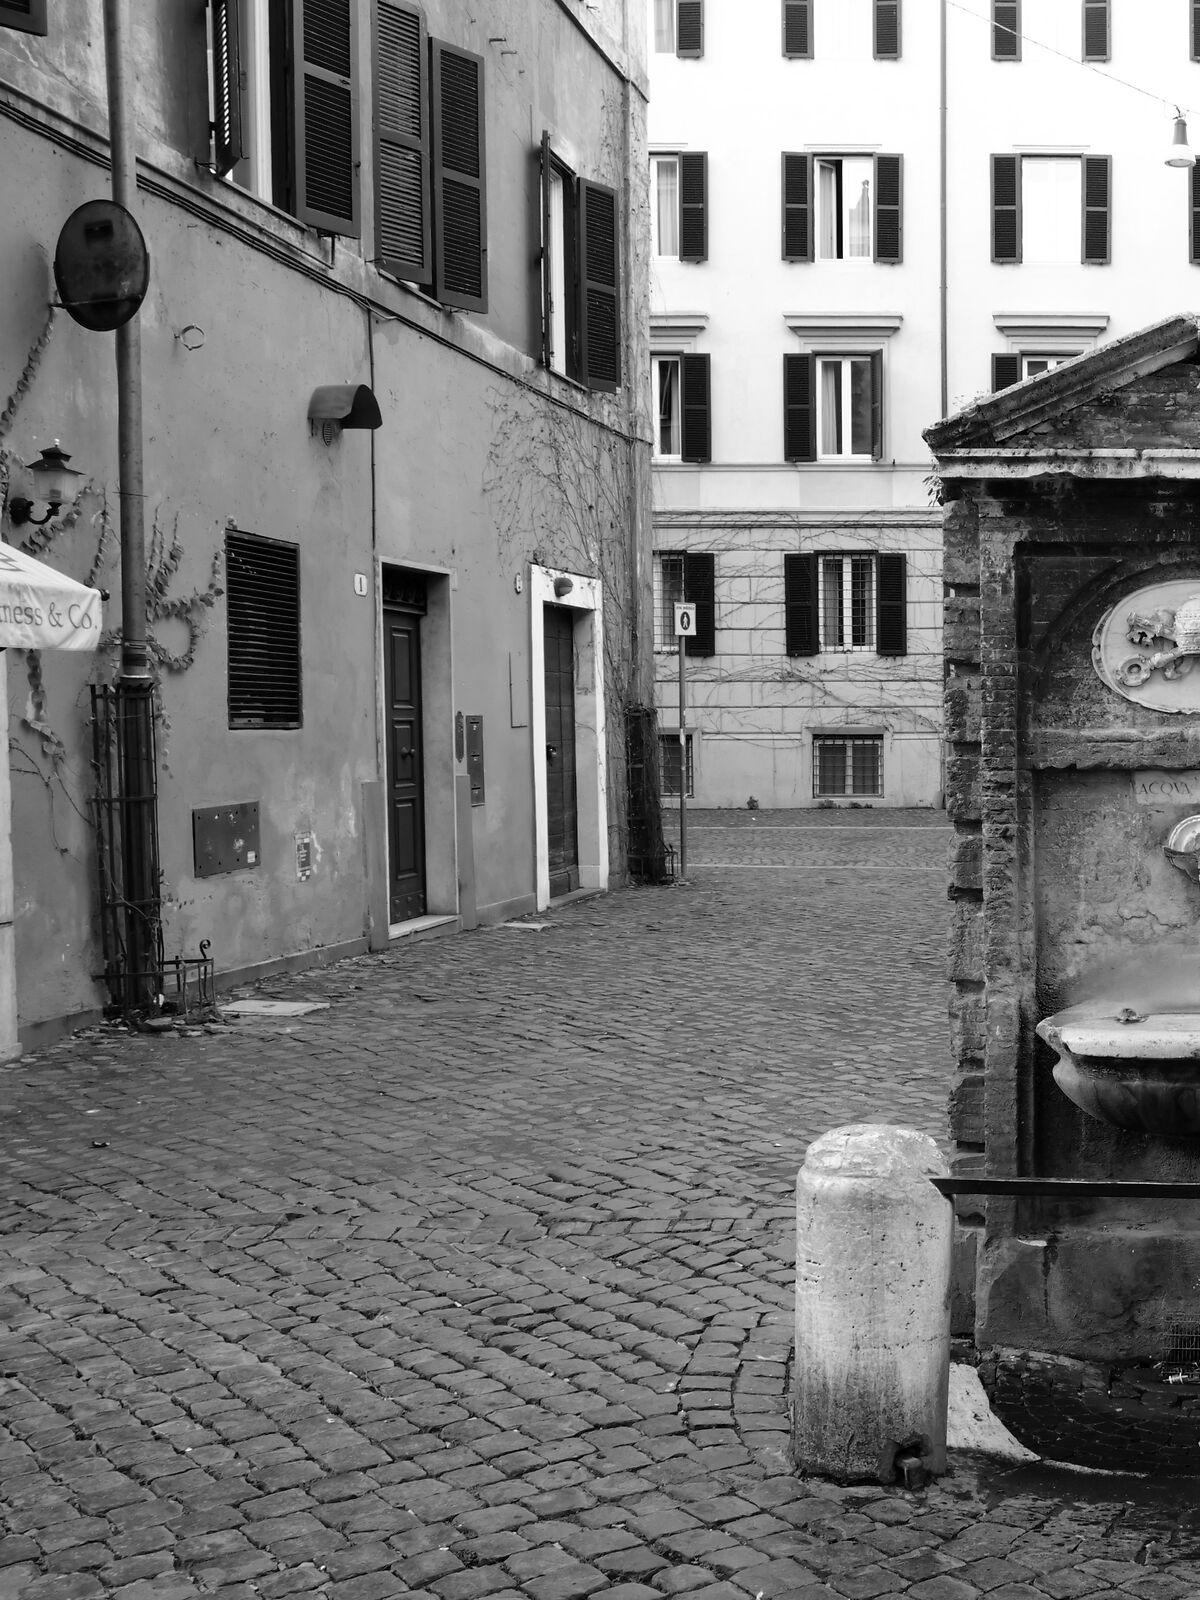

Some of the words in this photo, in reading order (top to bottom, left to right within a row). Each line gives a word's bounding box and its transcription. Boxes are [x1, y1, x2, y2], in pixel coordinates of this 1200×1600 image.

[0, 604, 43, 625] ness
[48, 601, 63, 628] &
[68, 603, 98, 629] Co.
